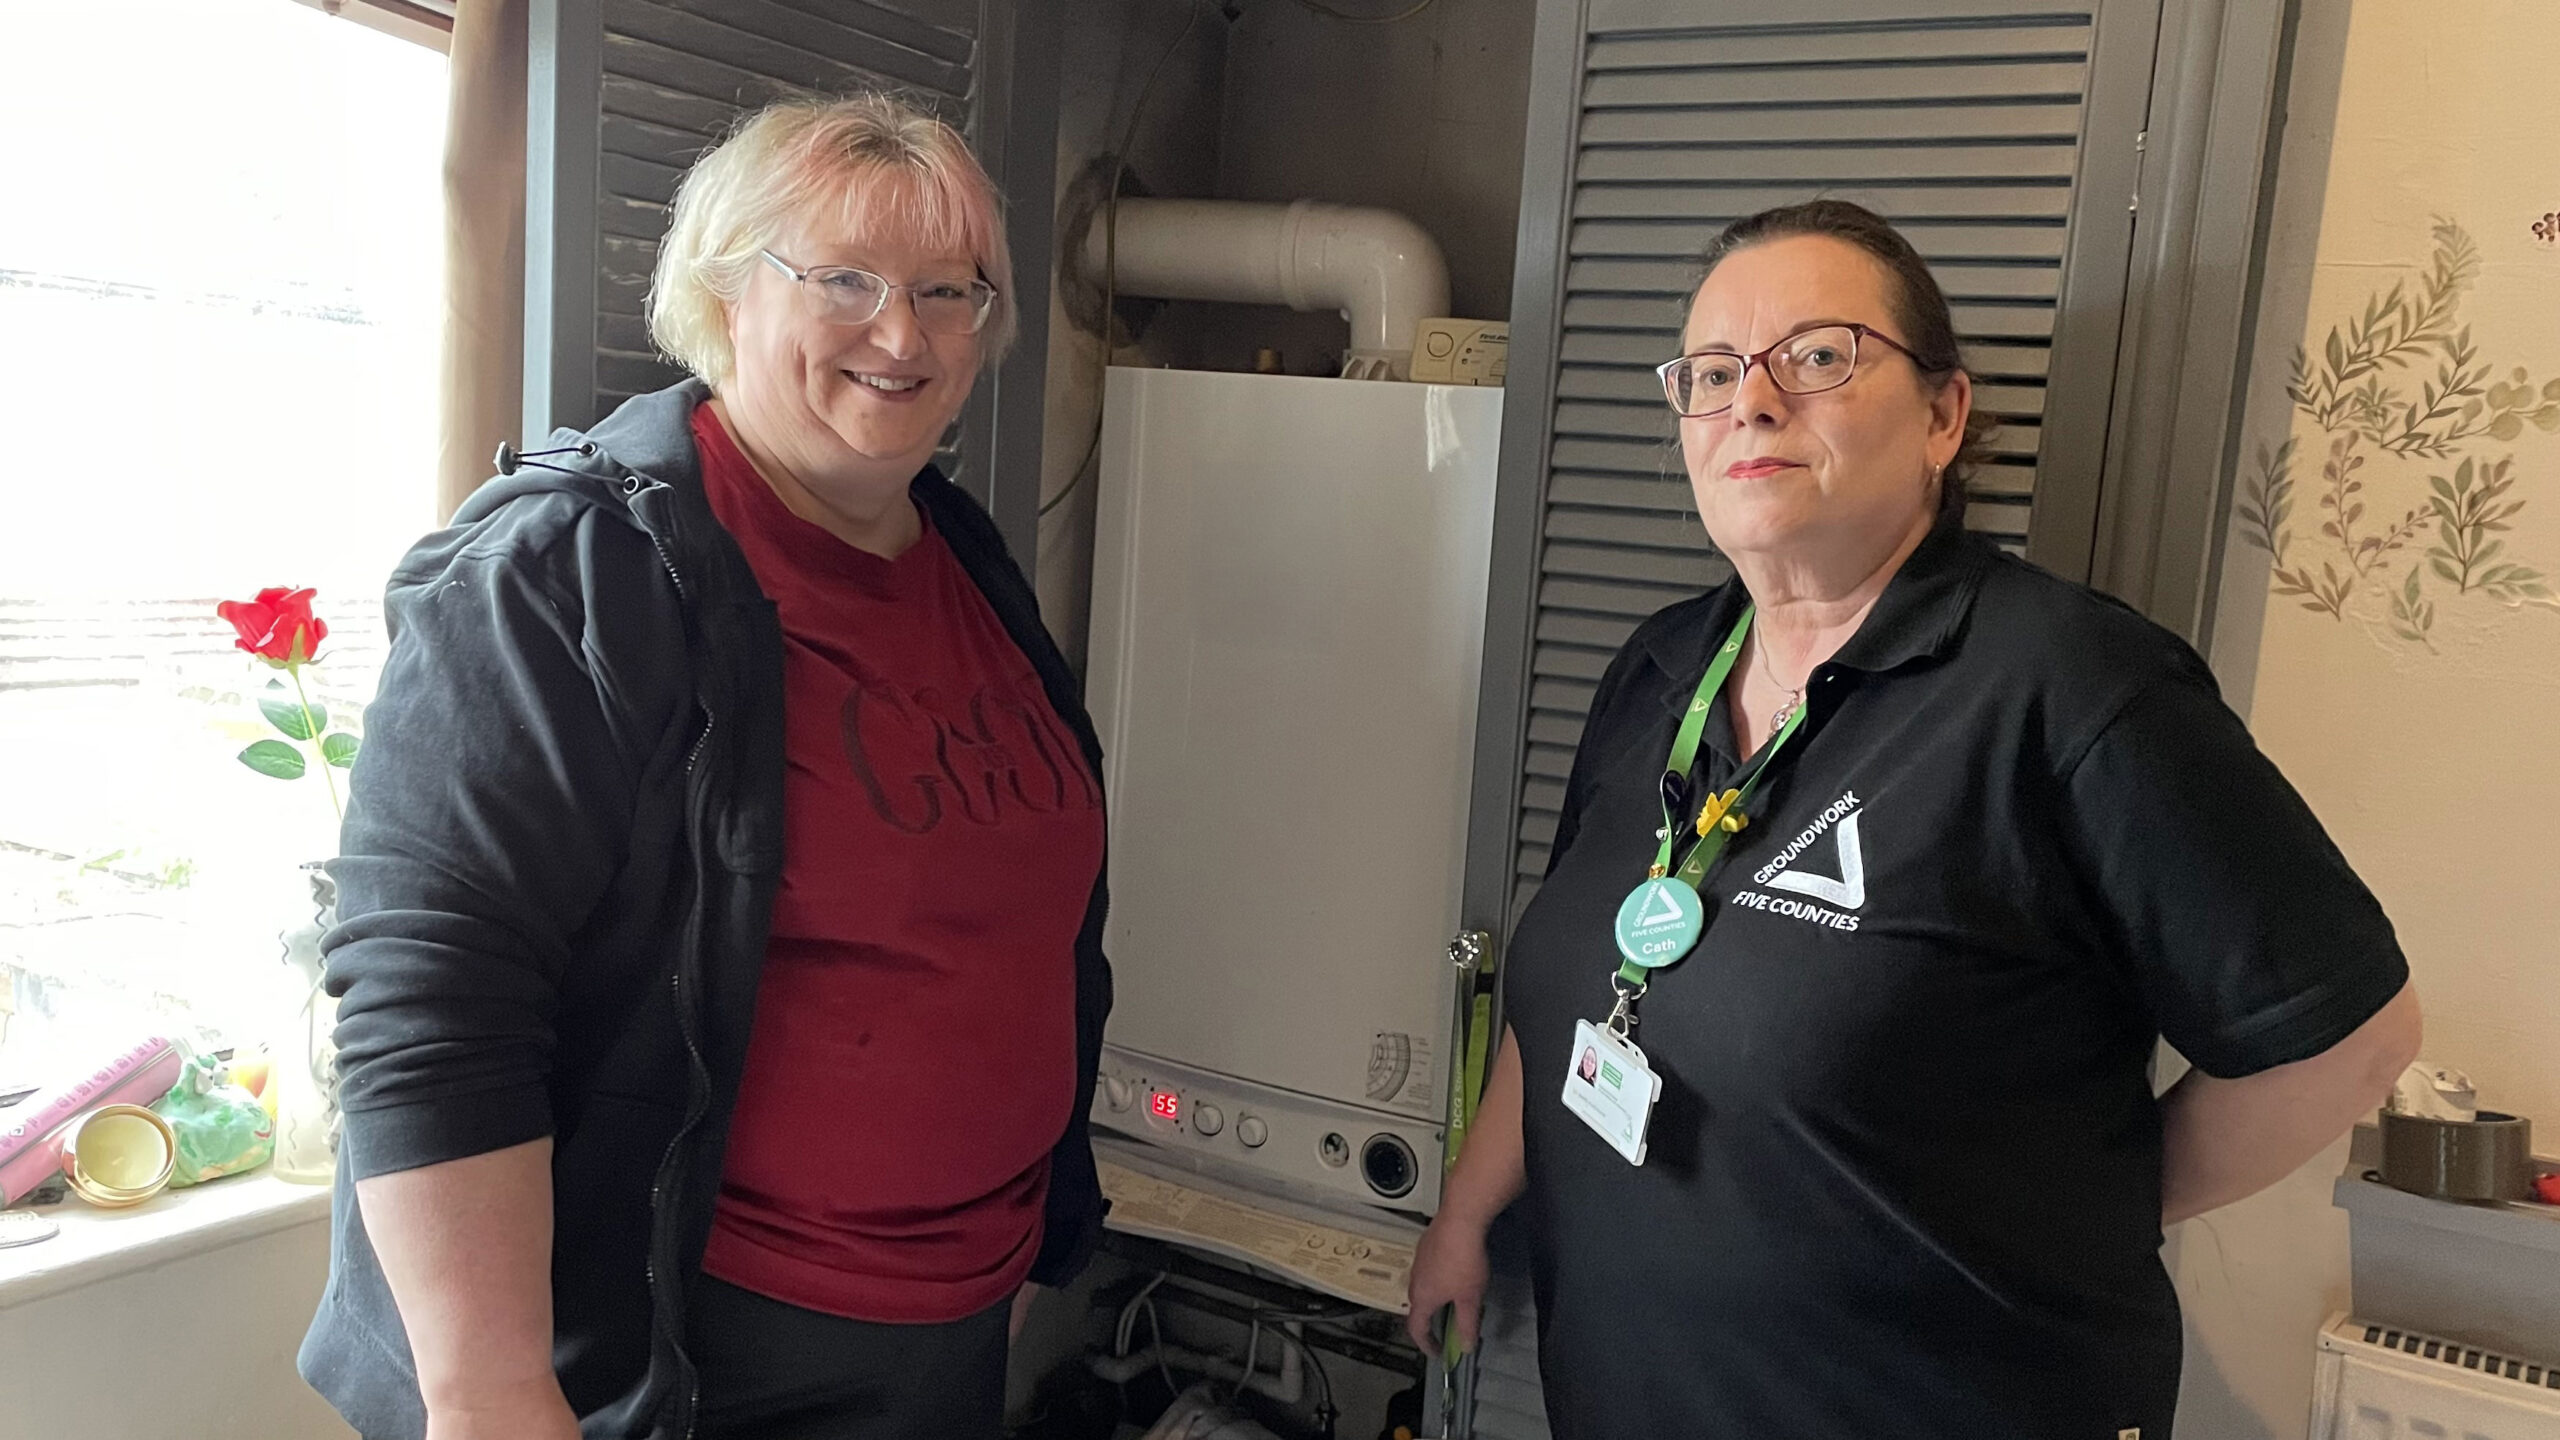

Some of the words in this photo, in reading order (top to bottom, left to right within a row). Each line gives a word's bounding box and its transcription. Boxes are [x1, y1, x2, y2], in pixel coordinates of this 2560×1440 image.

[1753, 790, 1861, 884] GROUNDWORK
[1732, 890, 1771, 910] FIVE
[1768, 899, 1861, 932] COUNTIES
[1631, 928, 1648, 938] FIVE
[1649, 921, 1686, 935] COUNTIES
[1642, 938, 1676, 954] Cath
[1156, 1094, 1177, 1114] 55
